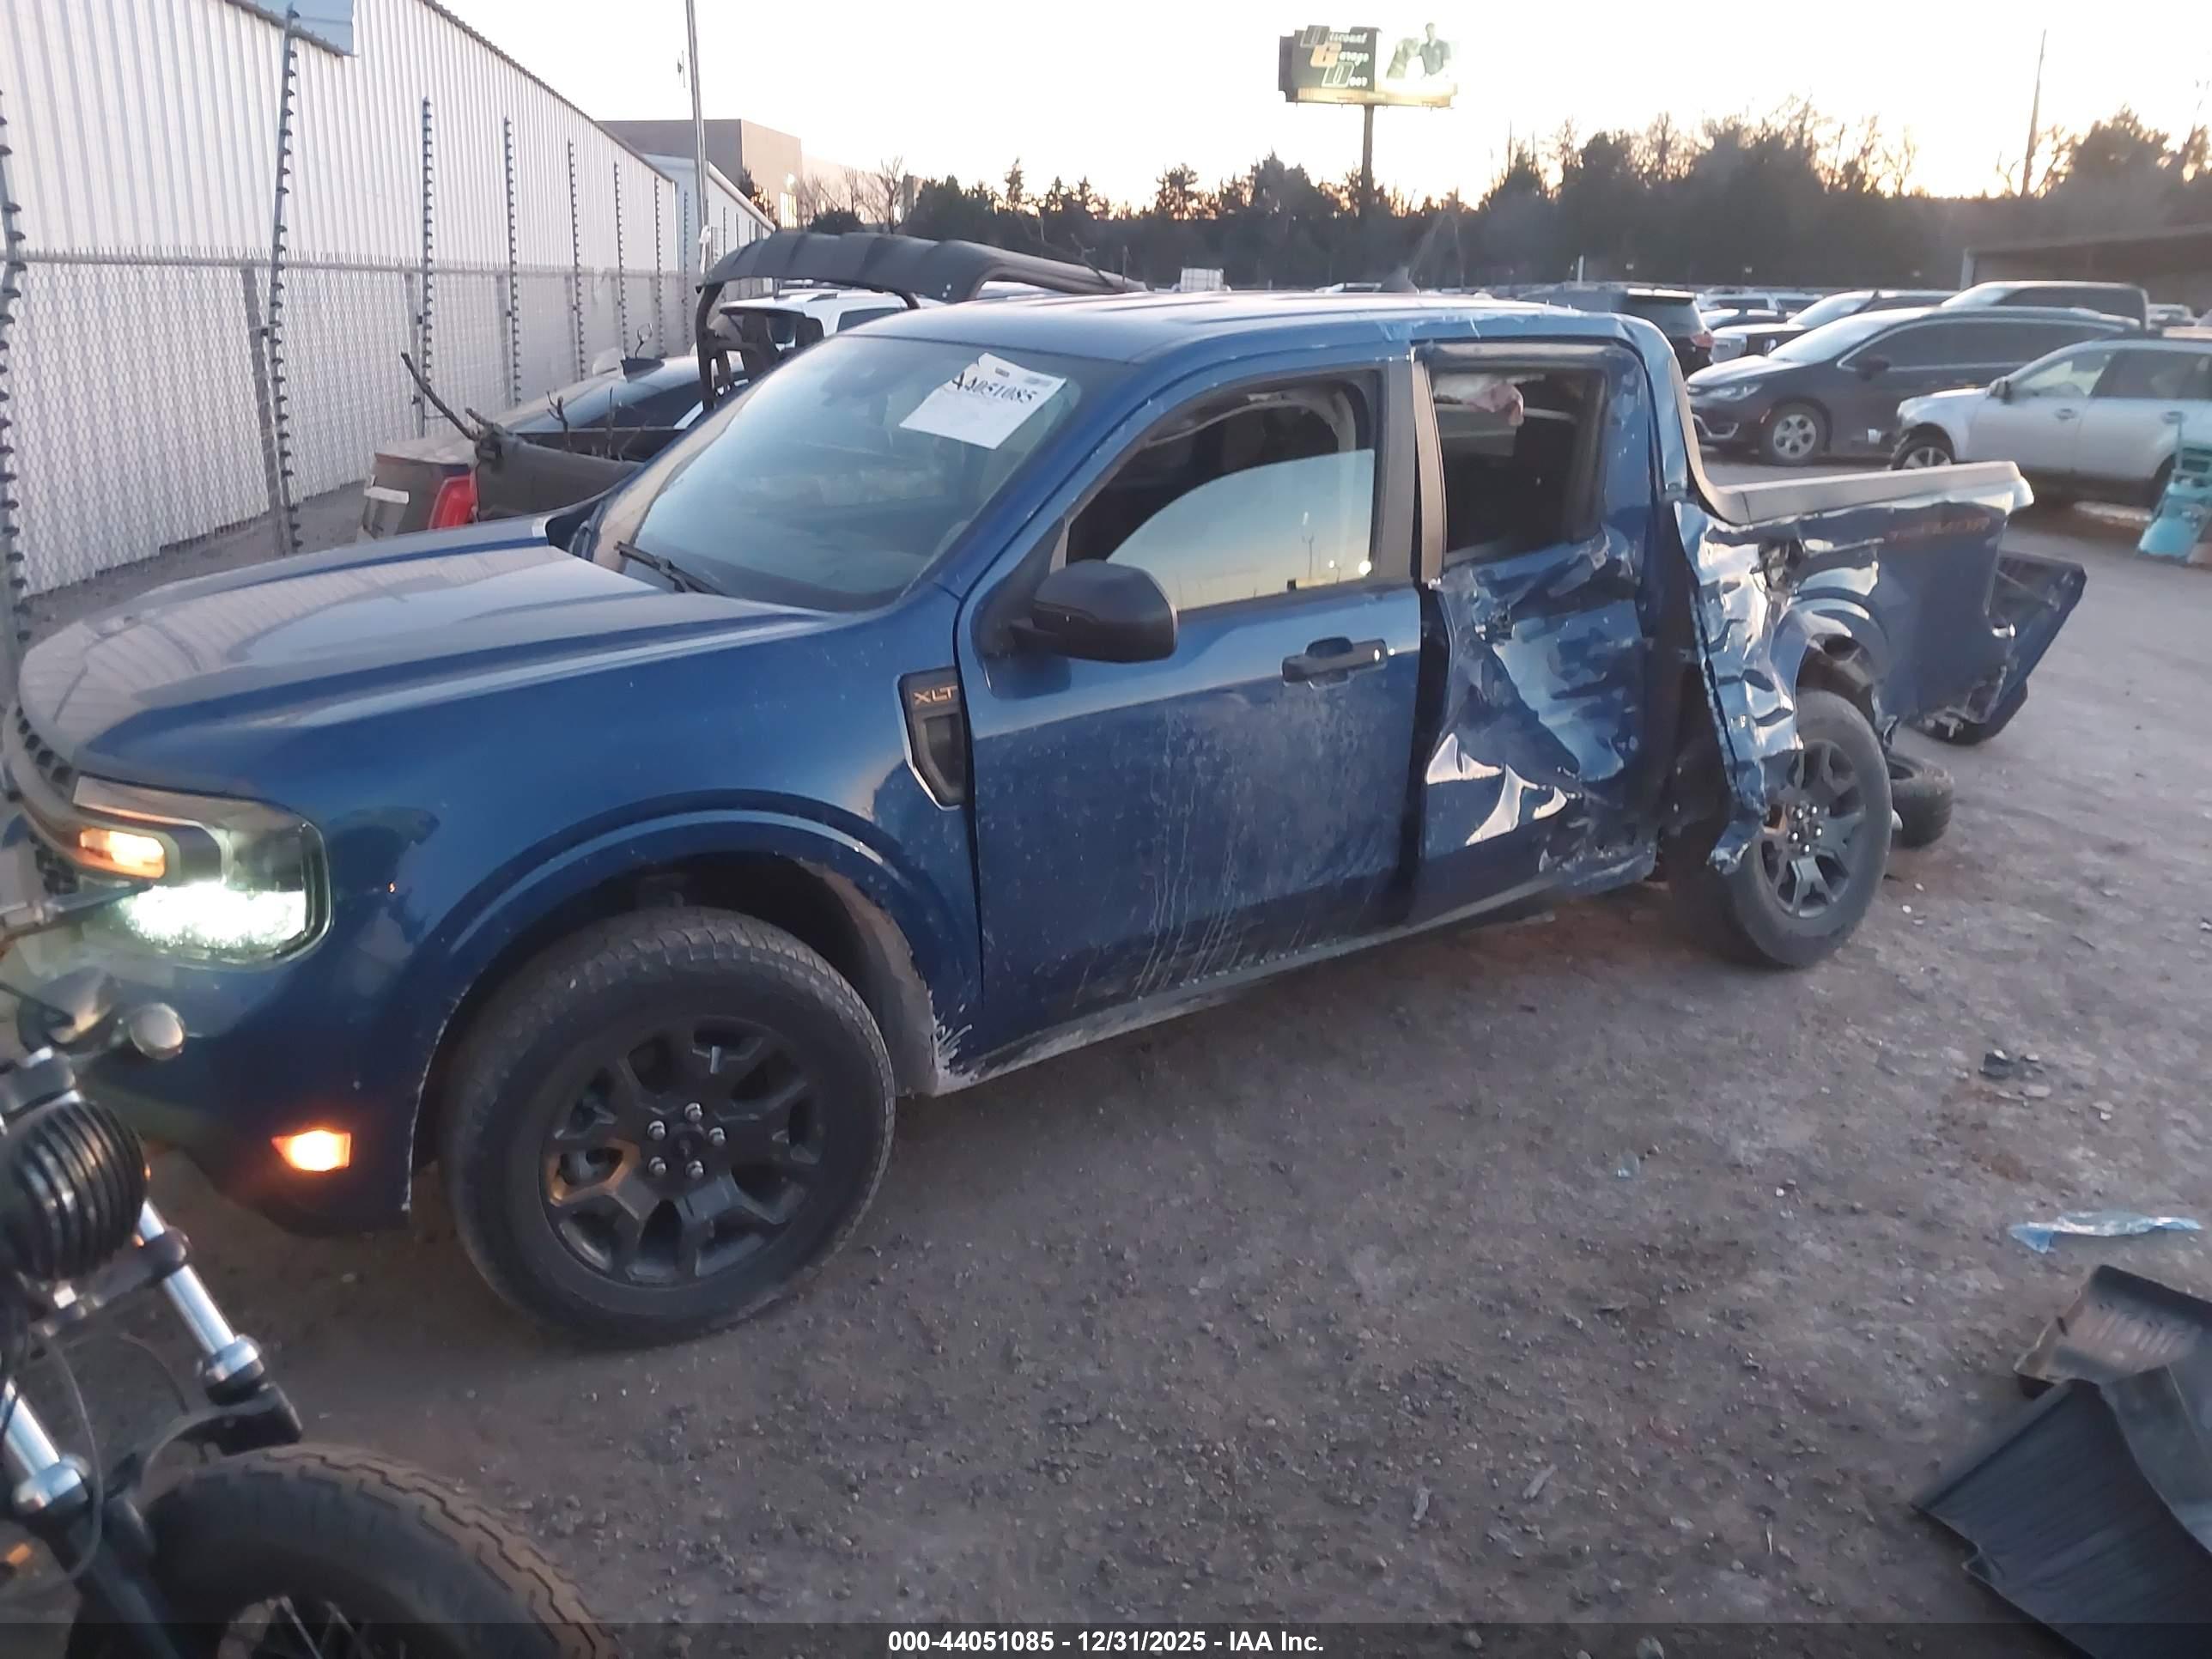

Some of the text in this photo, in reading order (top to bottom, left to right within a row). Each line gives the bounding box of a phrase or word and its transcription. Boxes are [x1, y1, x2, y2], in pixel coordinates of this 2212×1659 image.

[1310, 41, 1370, 68] Garage
[1321, 61, 1369, 88] Door
[913, 684, 958, 705] XLT
